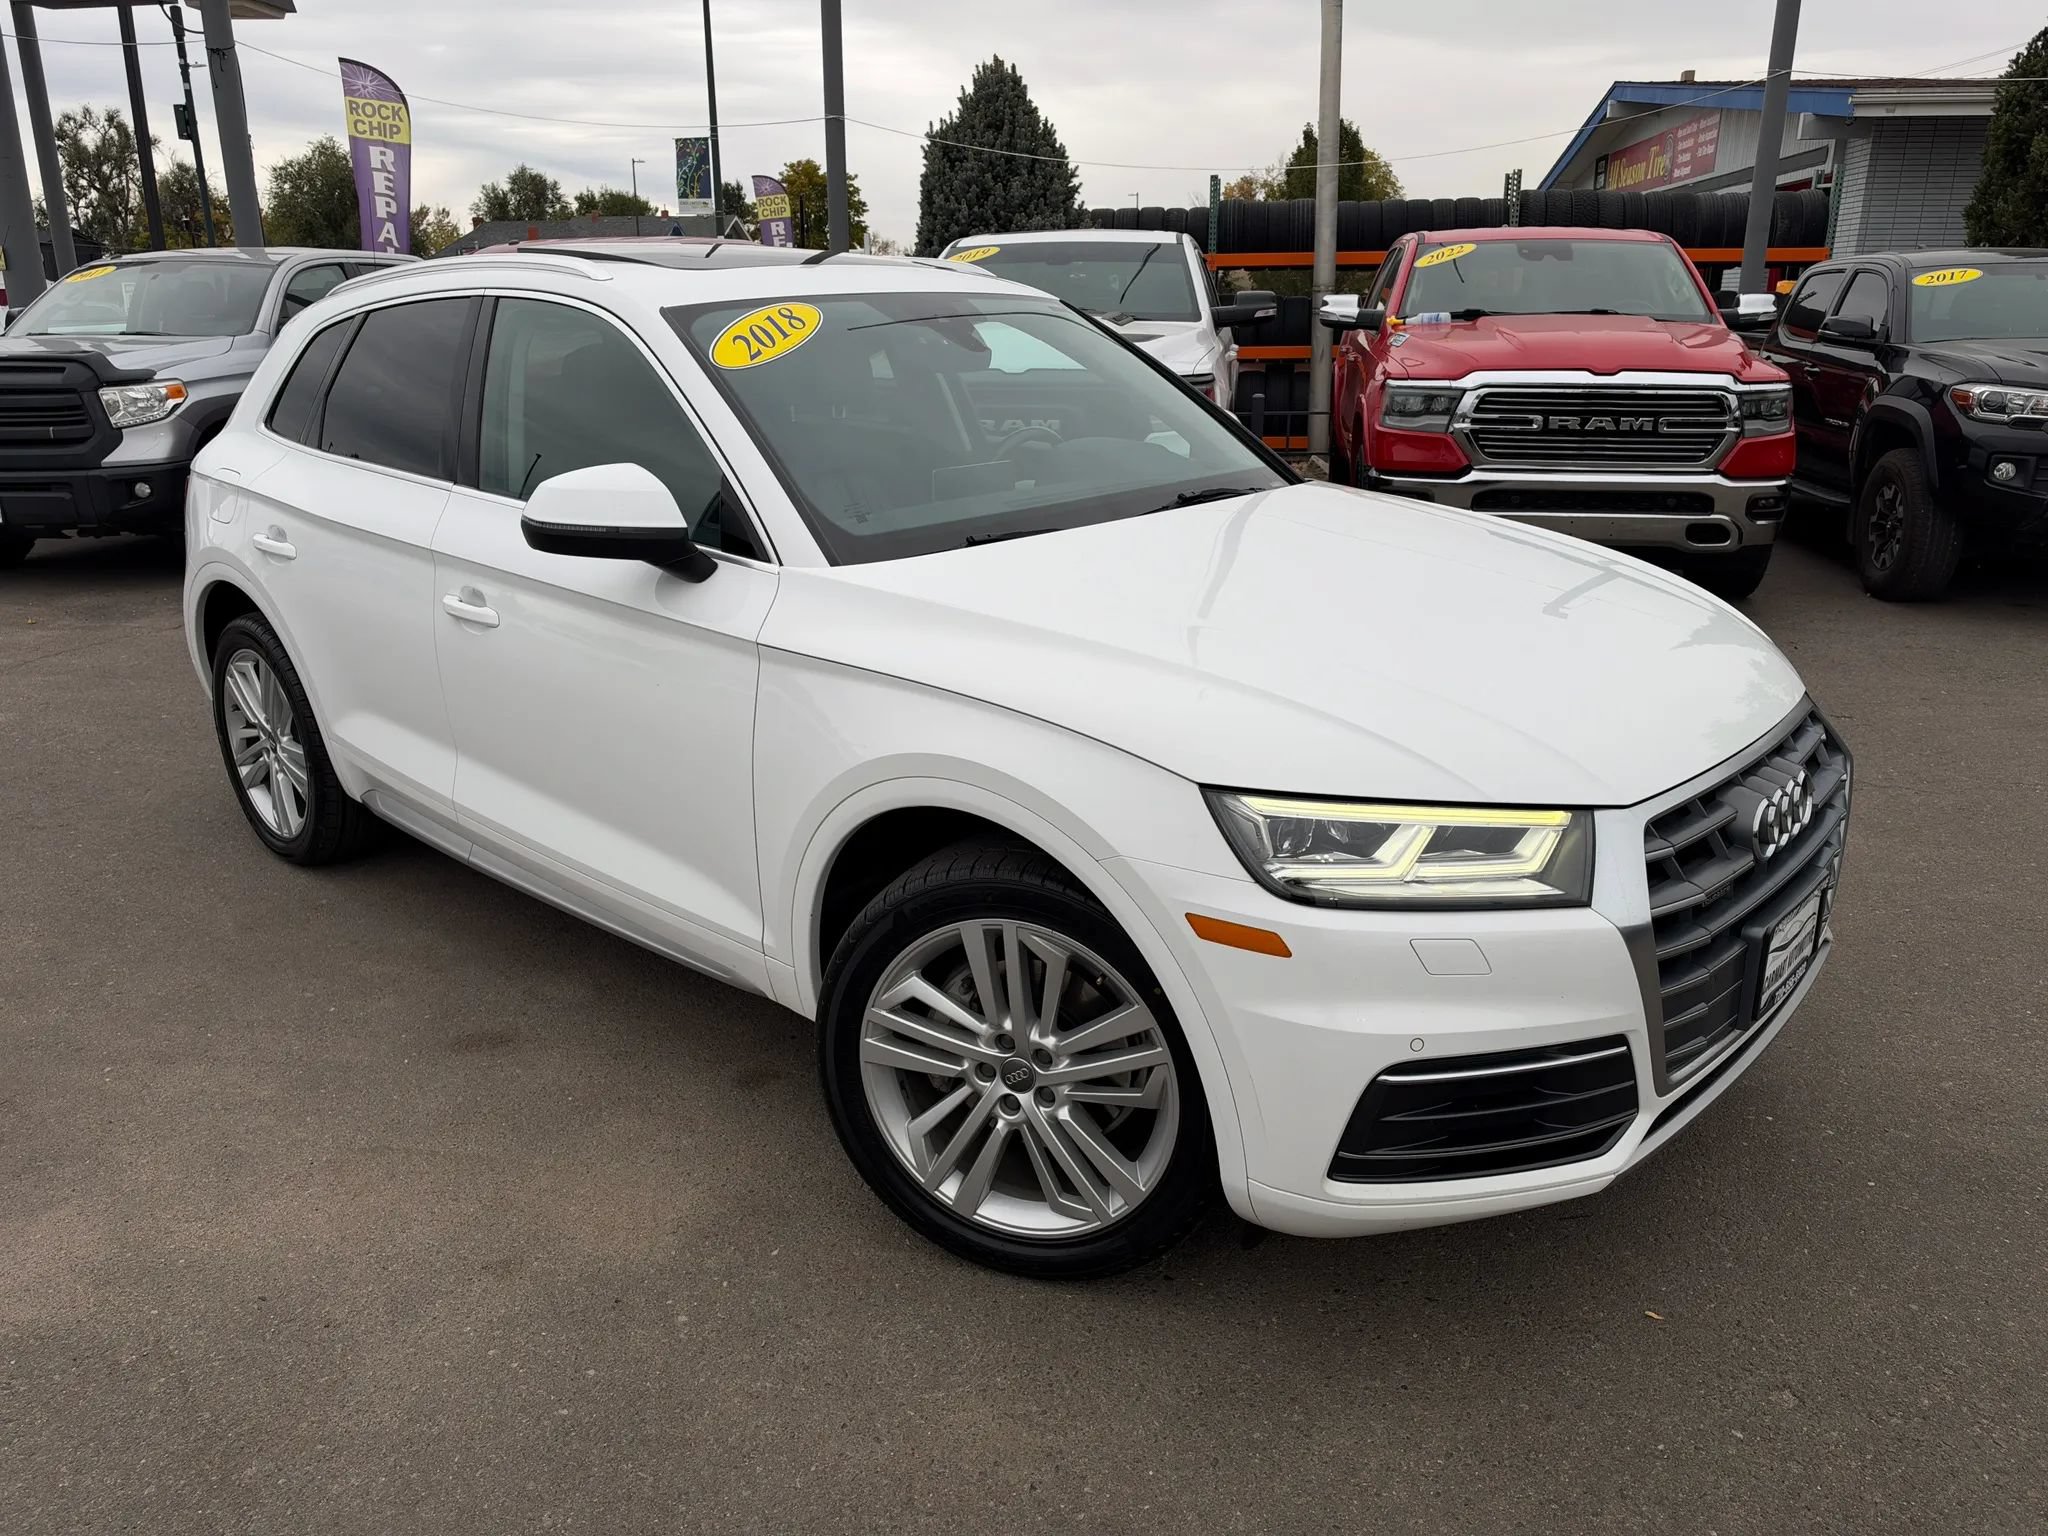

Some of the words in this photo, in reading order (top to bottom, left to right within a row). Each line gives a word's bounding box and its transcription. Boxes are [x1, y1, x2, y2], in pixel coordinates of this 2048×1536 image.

[350, 101, 403, 123] ROCK
[353, 119, 402, 140] CHIP
[1619, 158, 1646, 187] Season
[758, 196, 788, 209] ROCK
[761, 207, 787, 218] CHIP
[1427, 246, 1464, 264] 2022
[1926, 270, 1968, 284] 2017
[732, 307, 806, 362] 2018
[1548, 415, 1655, 431] RAM
